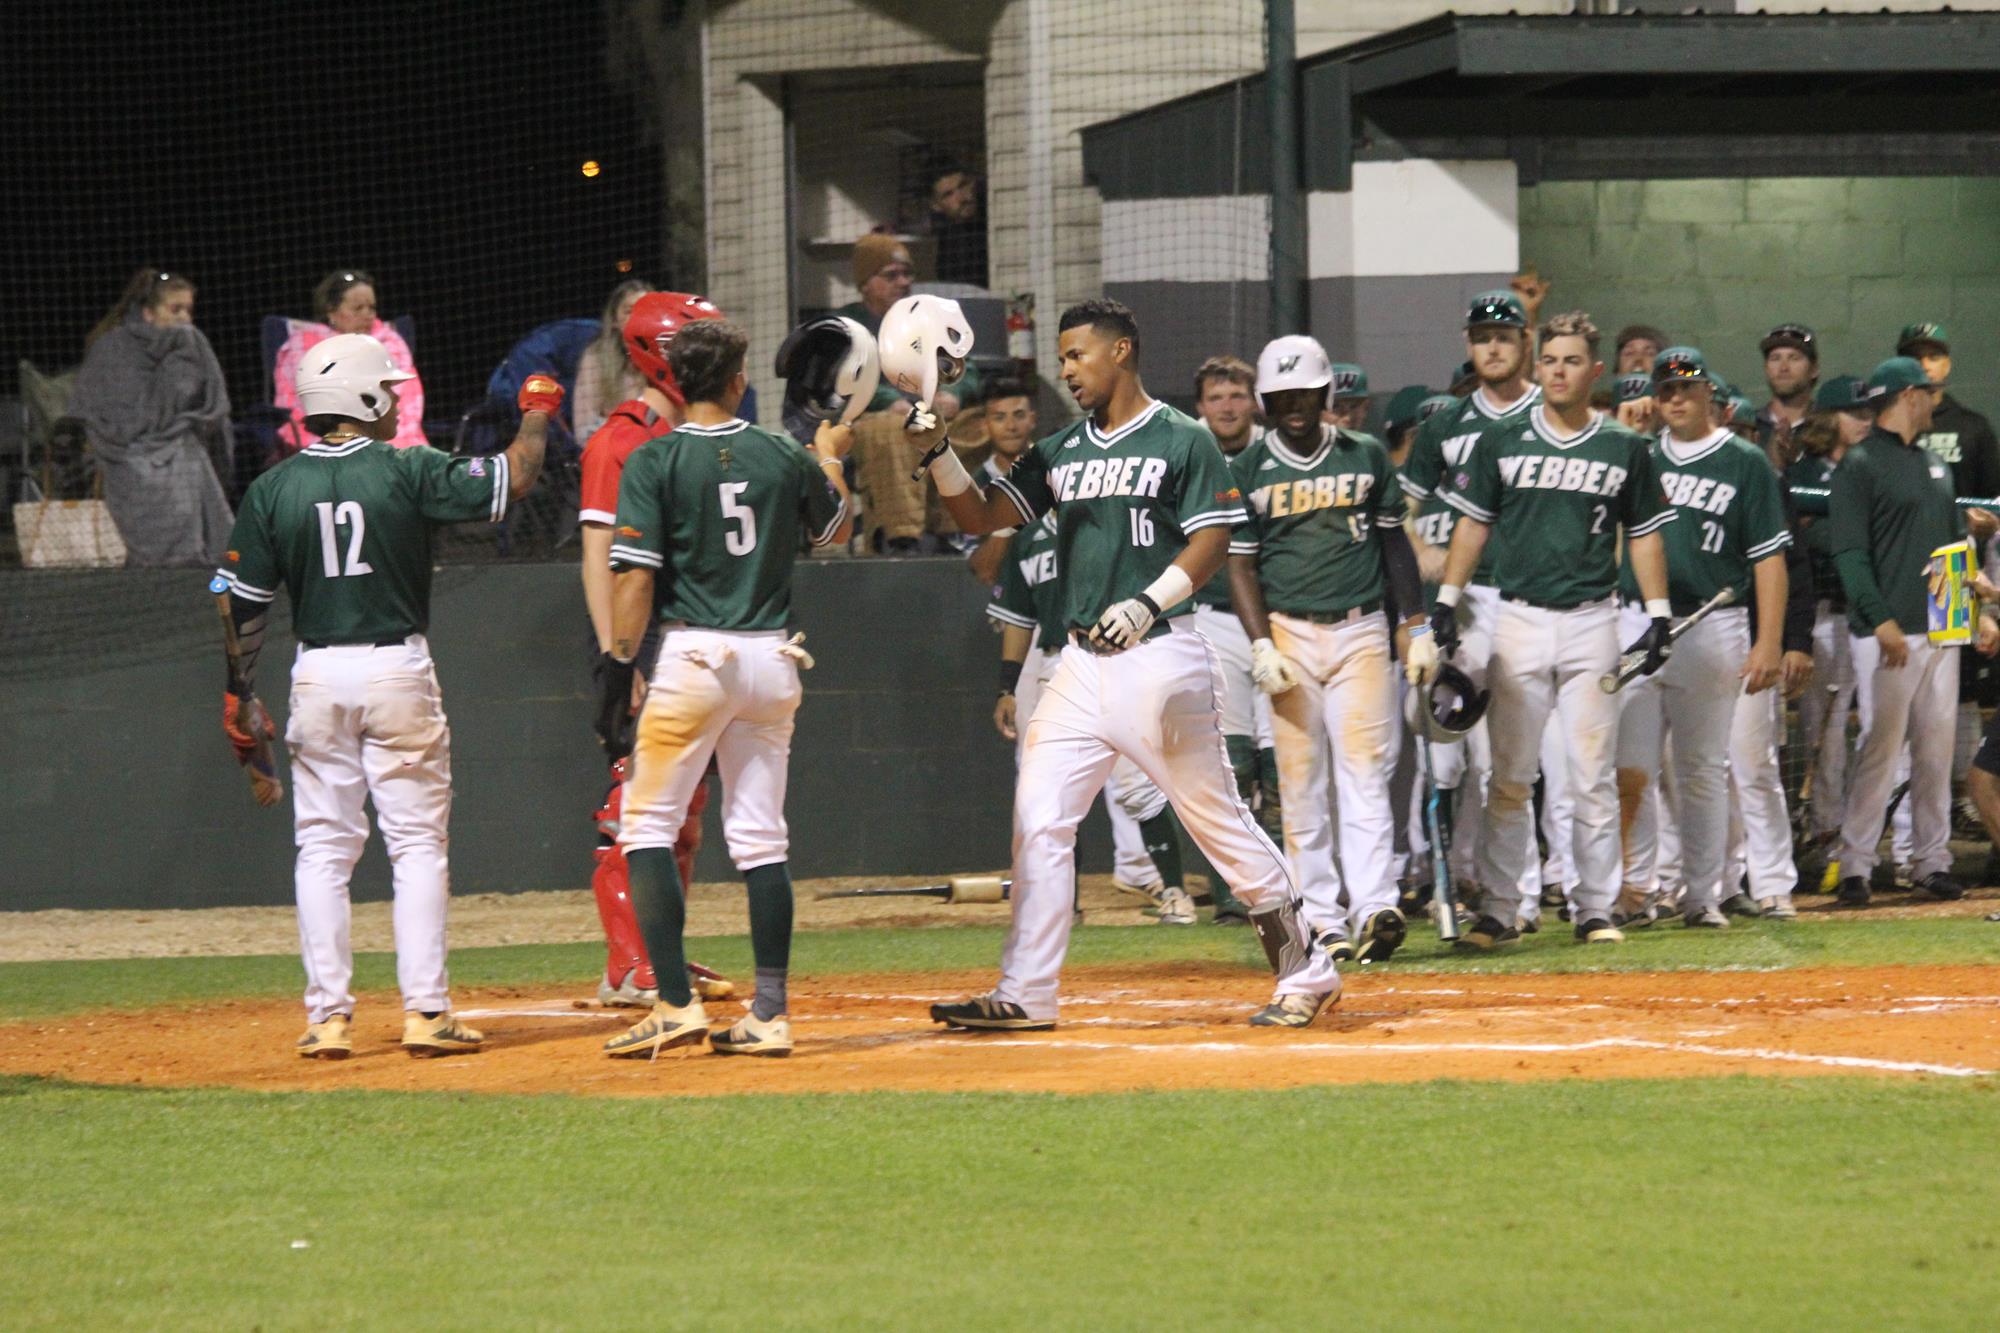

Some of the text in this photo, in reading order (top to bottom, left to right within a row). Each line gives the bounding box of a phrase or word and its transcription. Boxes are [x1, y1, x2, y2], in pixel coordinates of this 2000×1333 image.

[1046, 456, 1168, 503] WEBBER
[1248, 473, 1375, 519] WEBBER
[1497, 455, 1628, 497] WEBBER
[314, 500, 374, 578] 12
[718, 481, 757, 556] 5
[1129, 507, 1155, 547] 16
[1589, 504, 1608, 534] 2
[1701, 520, 1725, 554] 21
